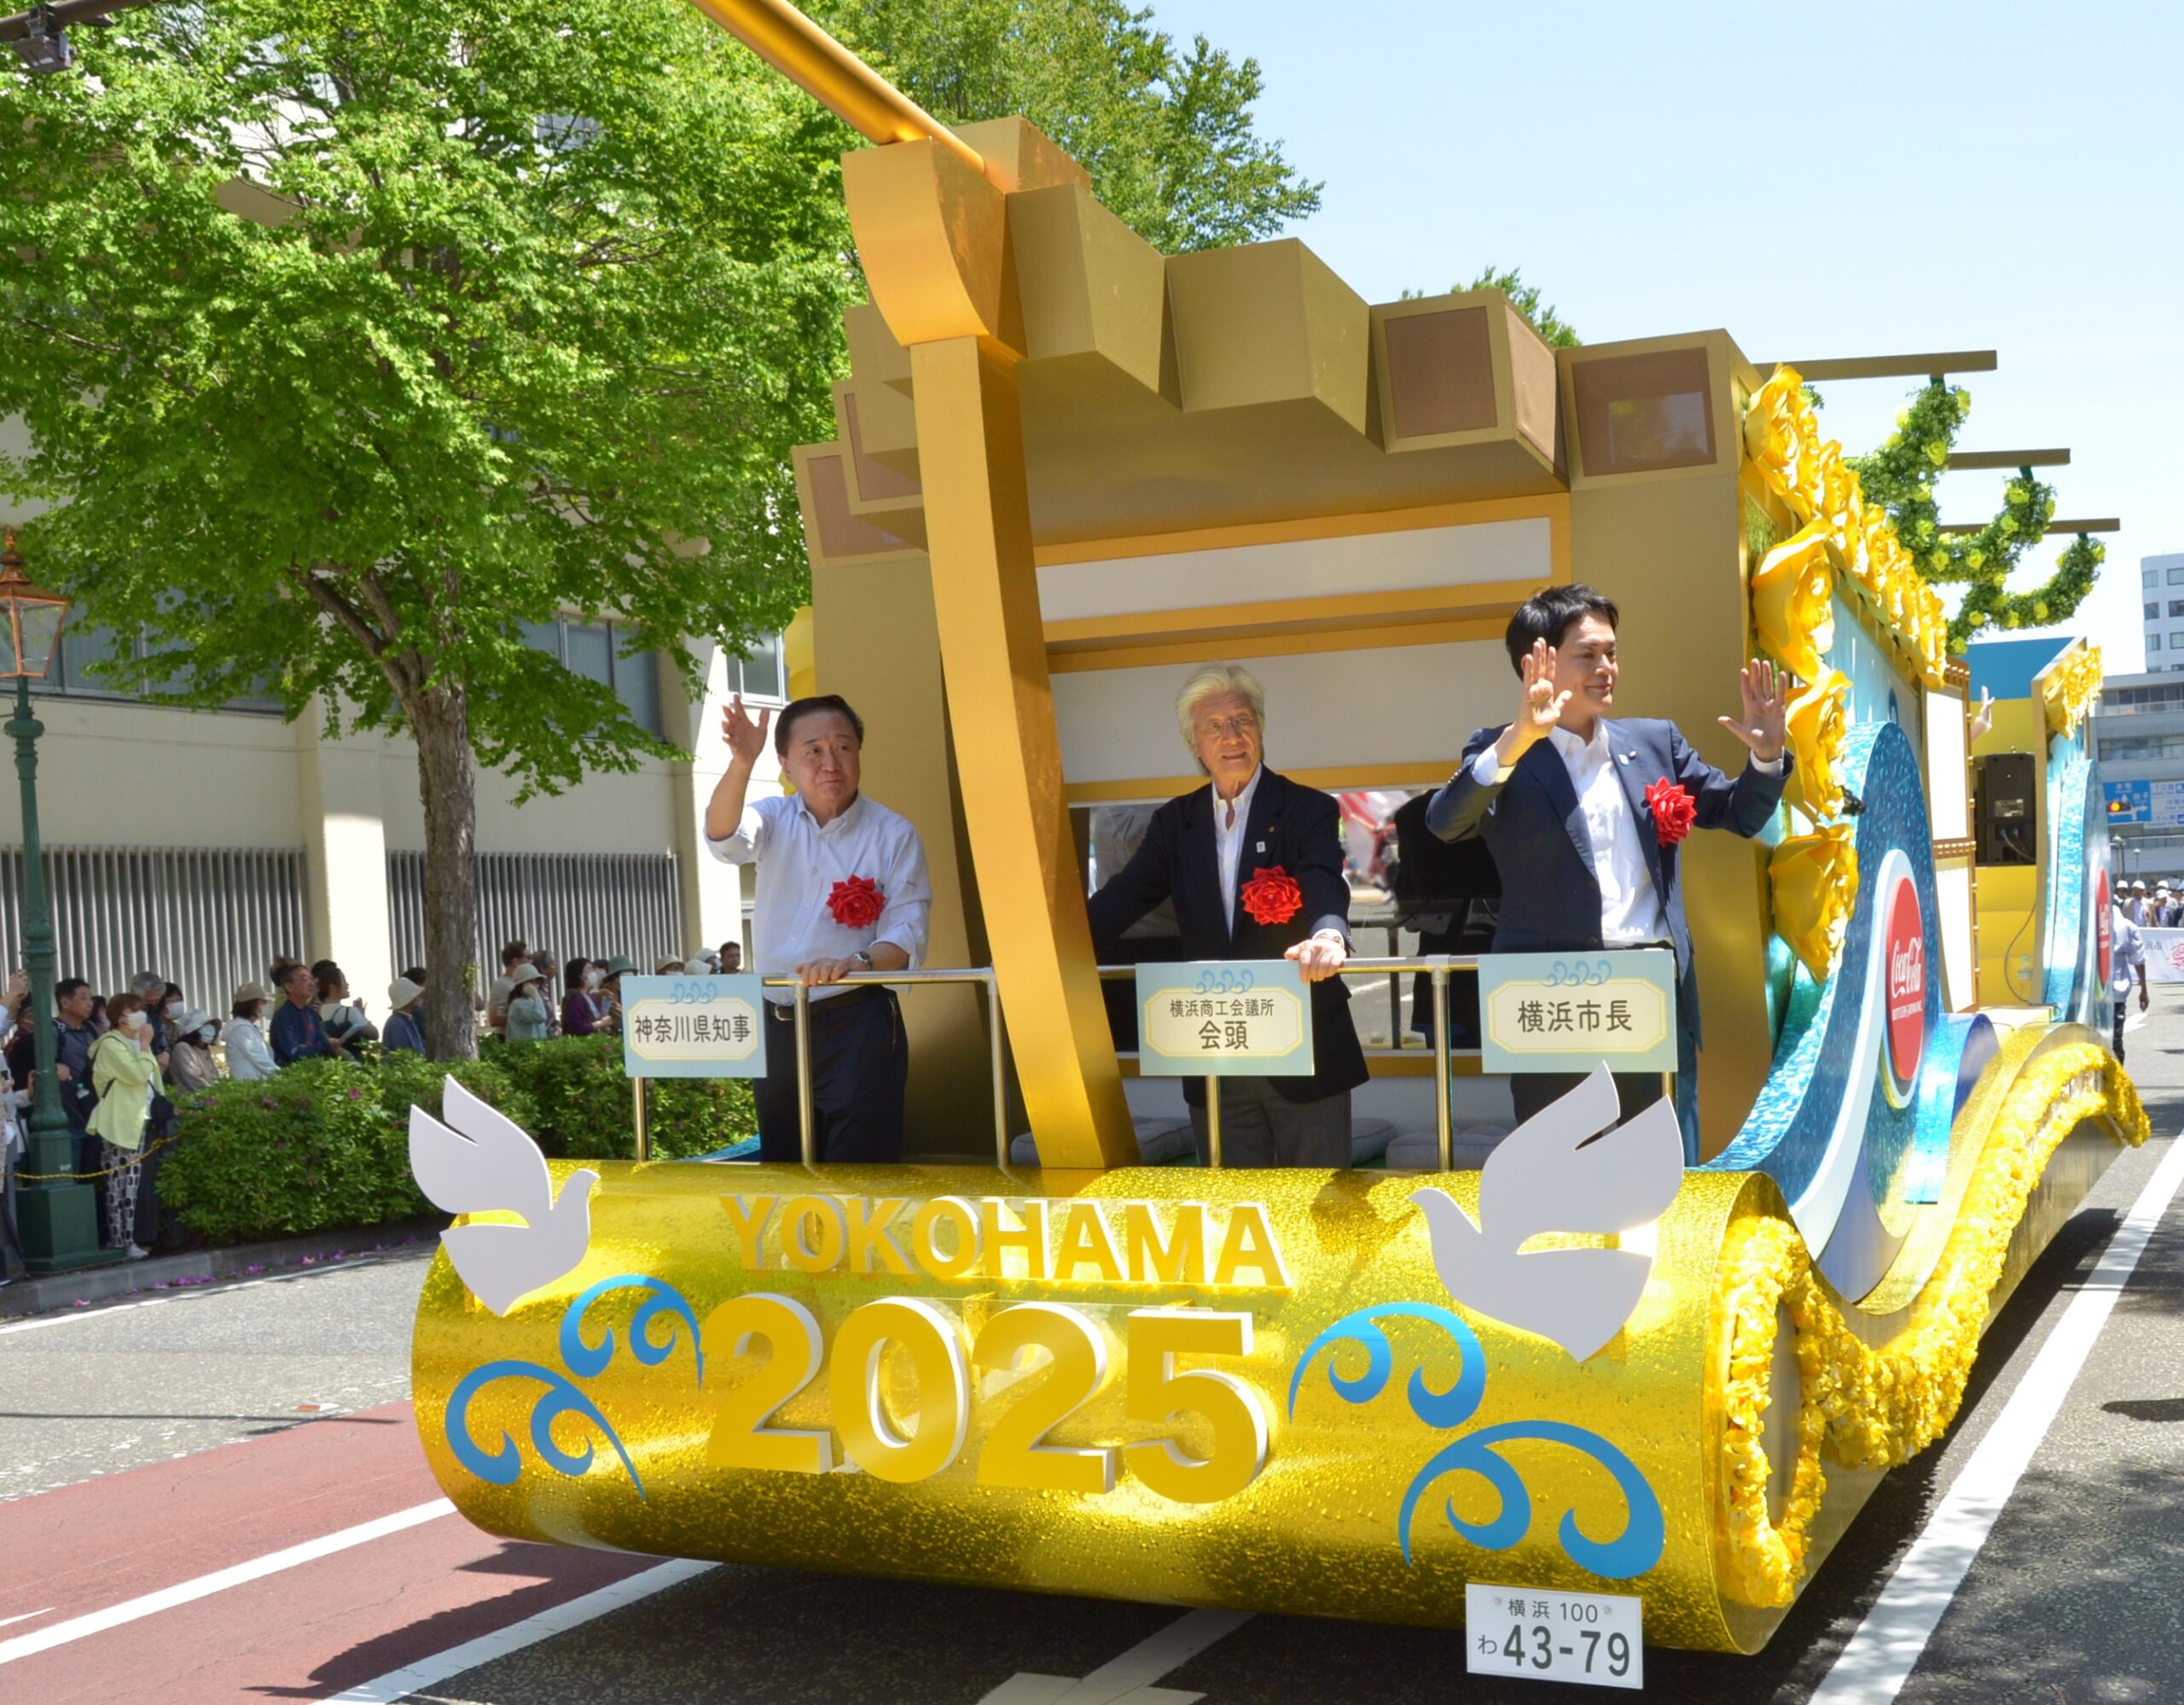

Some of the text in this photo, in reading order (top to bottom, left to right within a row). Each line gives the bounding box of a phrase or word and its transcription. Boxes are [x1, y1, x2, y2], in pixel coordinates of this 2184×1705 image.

[1170, 998, 1274, 1017] 横浜商工会議所
[1518, 999, 1632, 1033] 横浜市長
[635, 1014, 751, 1043] 神奈川県知事
[1199, 1020, 1249, 1050] 会頭
[717, 1193, 1292, 1287] YOKOHAMA
[700, 1291, 1269, 1504] 2025
[1507, 1598, 1598, 1623] 横浜 100
[1477, 1624, 1630, 1677] わ 43-79
